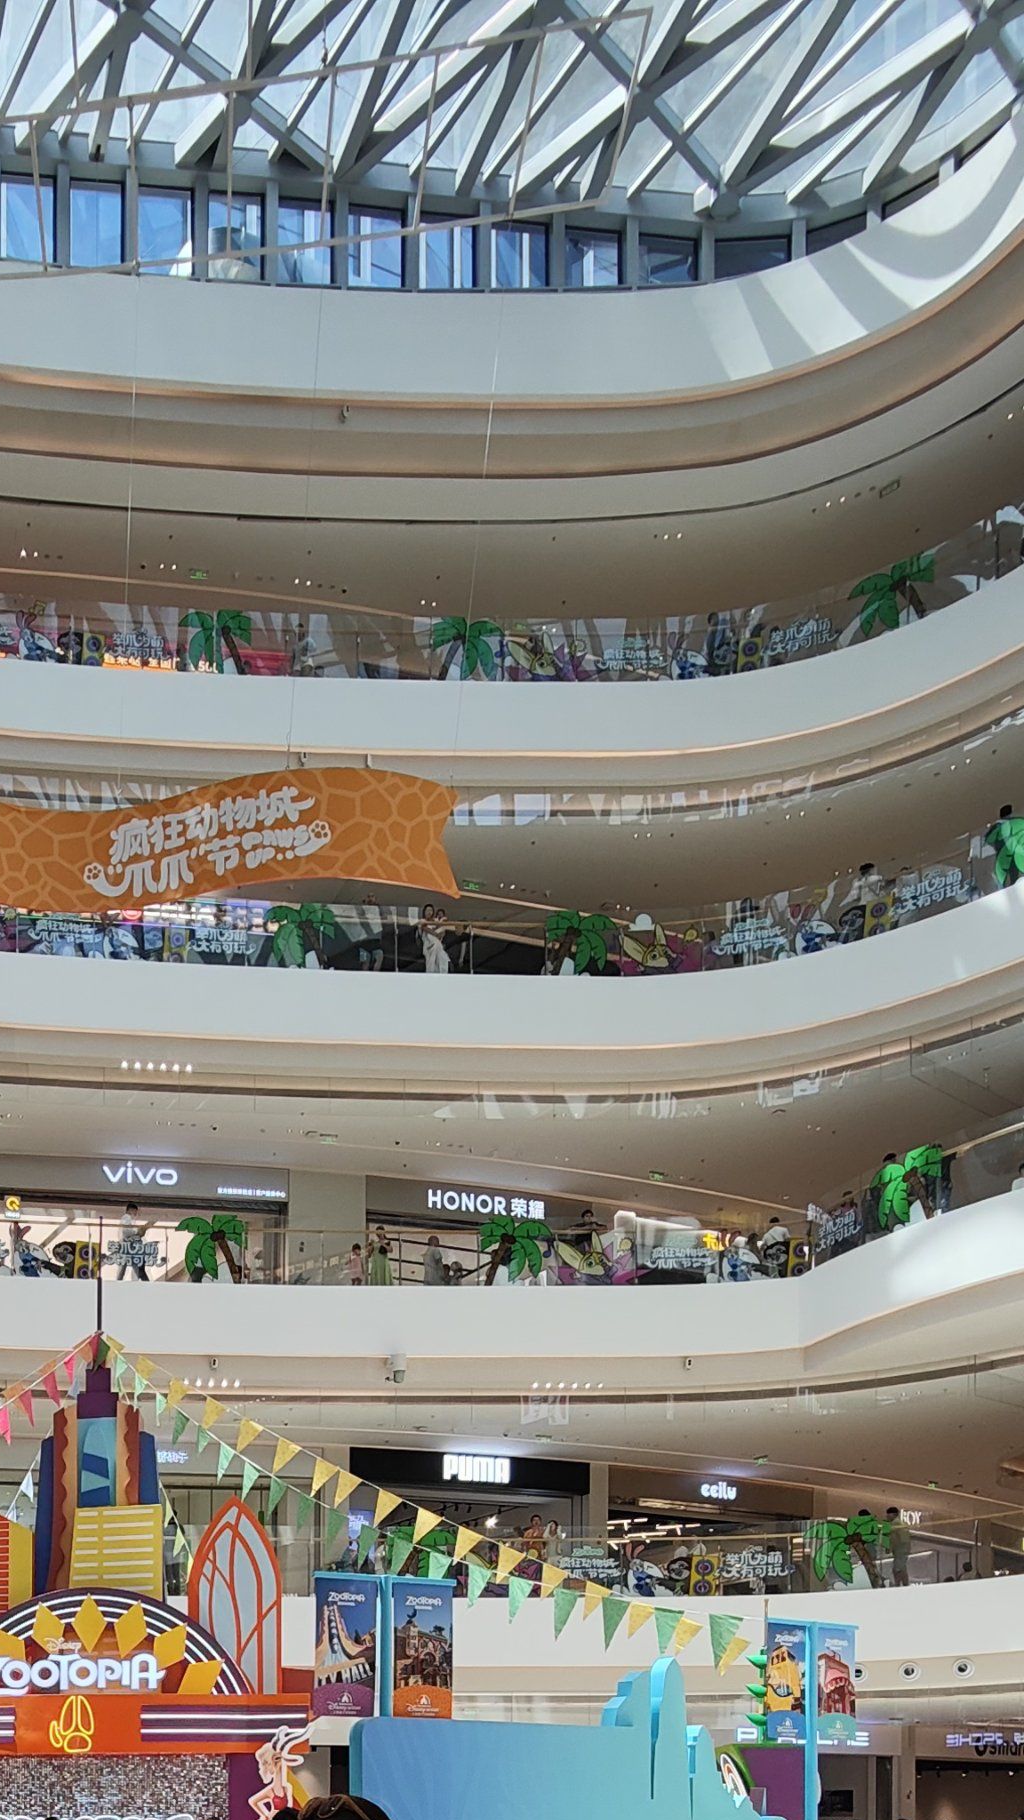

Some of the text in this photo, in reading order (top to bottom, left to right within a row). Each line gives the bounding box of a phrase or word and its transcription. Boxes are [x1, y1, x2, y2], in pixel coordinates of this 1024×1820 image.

[109, 786, 316, 865] 疯狂动物城
[103, 1161, 178, 1186] vivo
[427, 1188, 545, 1220] HONOR 荣耀
[443, 1454, 511, 1484] PUMA
